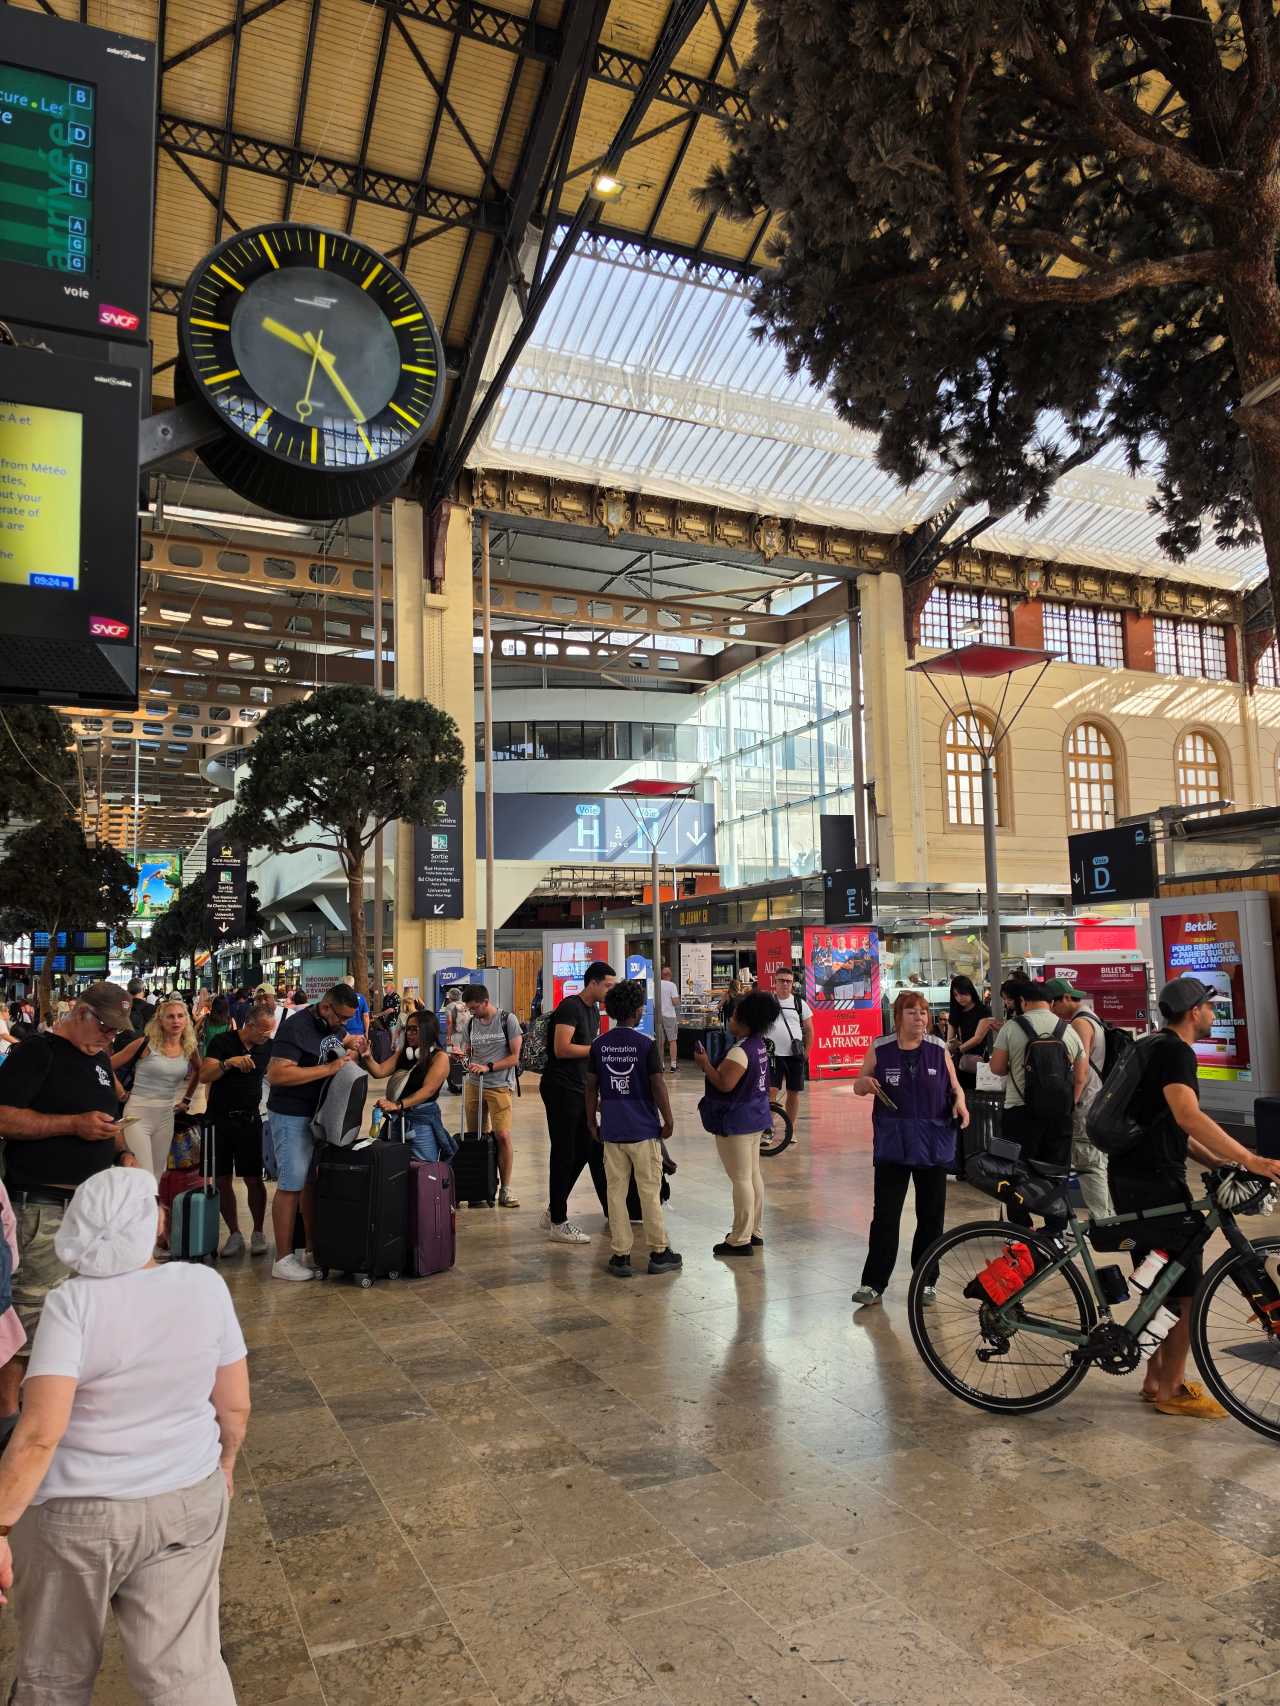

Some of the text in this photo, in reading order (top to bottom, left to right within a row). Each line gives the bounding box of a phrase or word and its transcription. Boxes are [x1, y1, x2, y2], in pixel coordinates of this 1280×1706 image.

[76, 90, 87, 103] B
[74, 128, 87, 141] D
[75, 183, 83, 194] L
[73, 220, 82, 232] A
[73, 239, 82, 250] G
[72, 258, 82, 267] G
[64, 286, 89, 299] voie
[100, 312, 138, 328] SNCF
[8, 412, 17, 424] A
[19, 415, 32, 426] et
[0, 458, 67, 476] from Météo
[28, 508, 41, 518] of
[34, 576, 60, 587] 09:24
[91, 623, 128, 636] SNCF
[580, 806, 599, 815] Voie
[577, 818, 599, 848] H
[615, 826, 622, 839] à
[1094, 867, 1110, 890] D
[848, 896, 856, 913] E
[1184, 919, 1217, 932] Betclic
[1172, 945, 1192, 953] POUR
[1224, 947, 1236, 955] LA
[1171, 954, 1241, 966] COUPE DU MONDE
[1101, 966, 1127, 974] BILLETS
[831, 1024, 860, 1036] ALLEZ
[600, 1045, 637, 1053] Orientation
[818, 1037, 833, 1049] LA
[601, 1054, 638, 1063] Information
